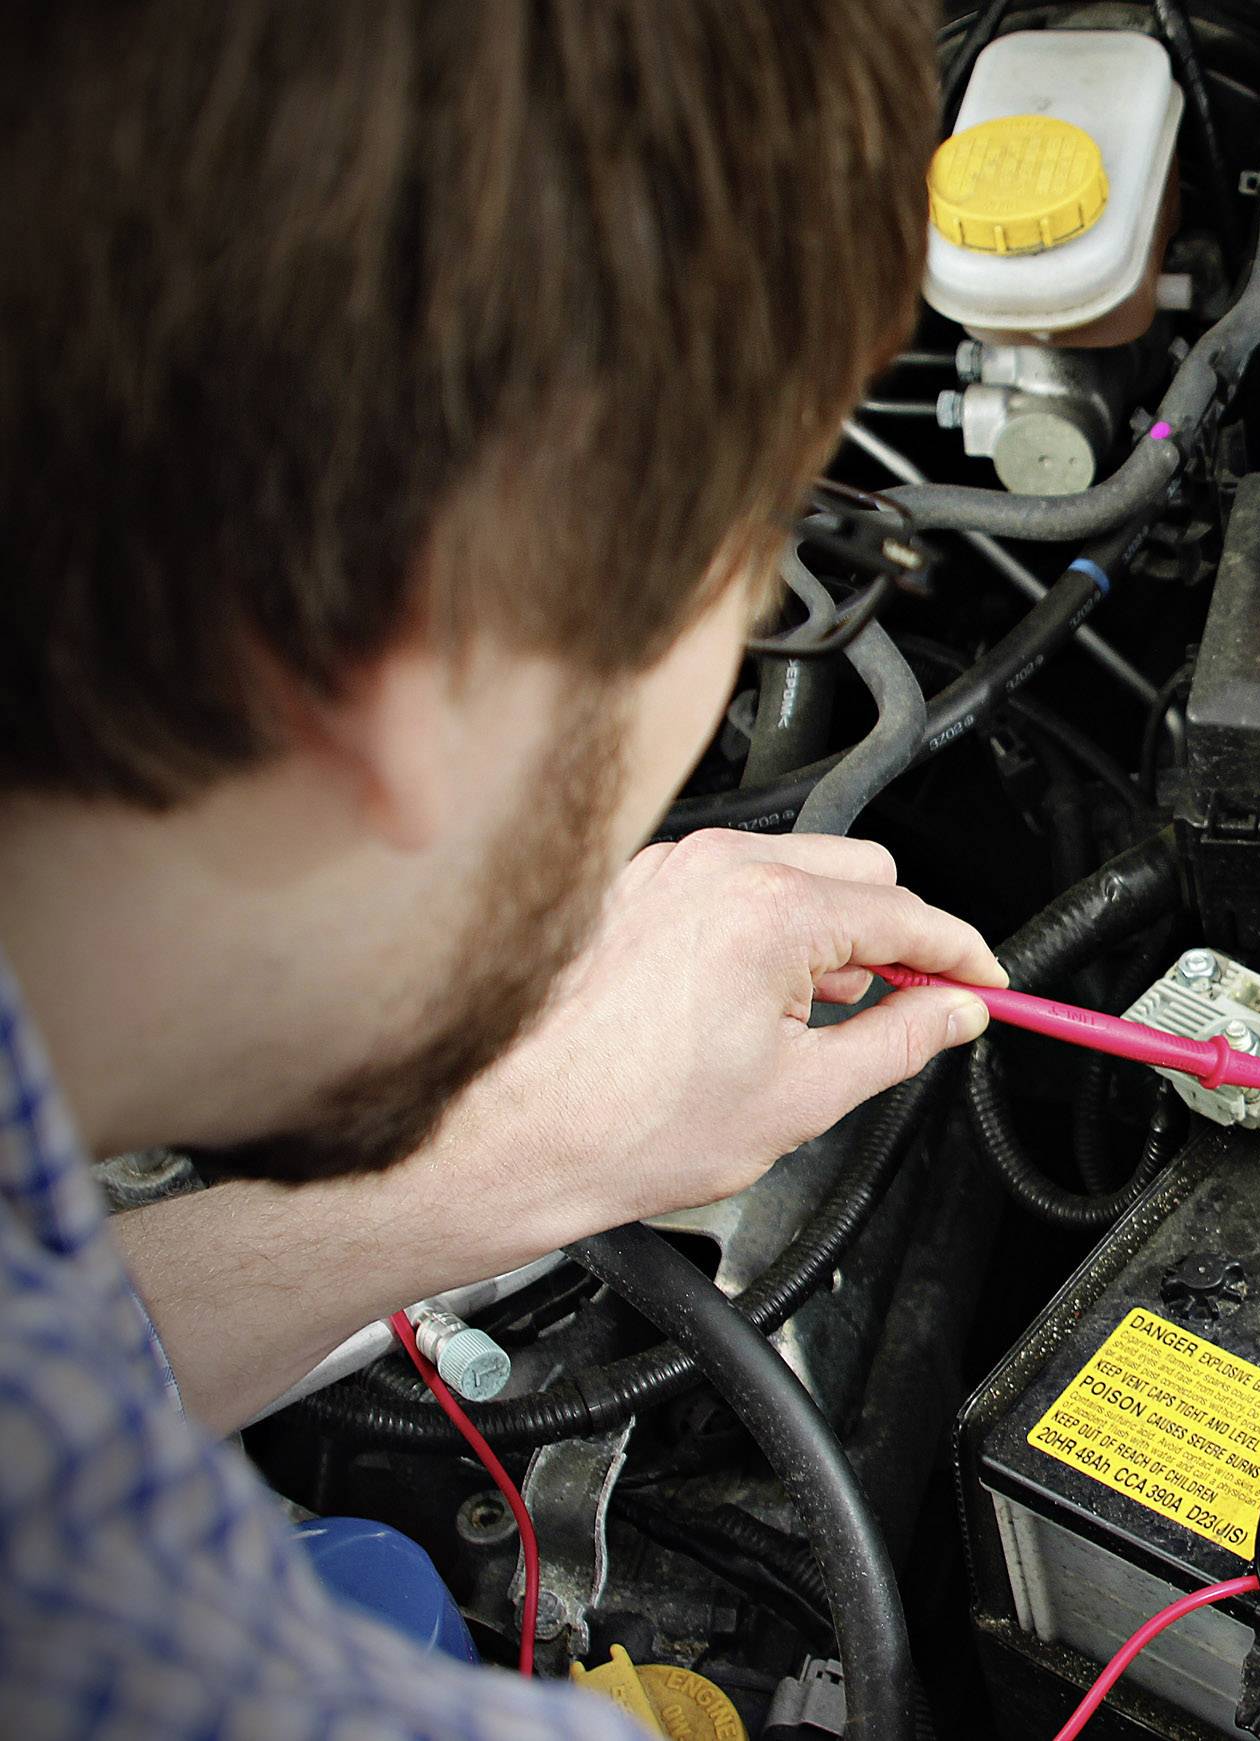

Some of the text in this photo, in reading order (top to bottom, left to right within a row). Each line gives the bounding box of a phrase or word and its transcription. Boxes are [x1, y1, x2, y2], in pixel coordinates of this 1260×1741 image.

[1130, 1315, 1198, 1357] DANGER
[1198, 1352, 1254, 1386] EXPLOSIVE
[1079, 1375, 1147, 1417] POISON
[1146, 1412, 1188, 1440] CAUSES
[1186, 1433, 1227, 1460] SEVERE
[1094, 1359, 1260, 1453] KEEP VENT CAPS TIGHT AND LEVEL
[1036, 1426, 1248, 1546] 20HR 48Ah CCA 390A D23(JIS)
[1052, 1410, 1218, 1504] KEEP OUT OF REACH OF CHILDREN
[666, 1670, 737, 1741] ENGINE
